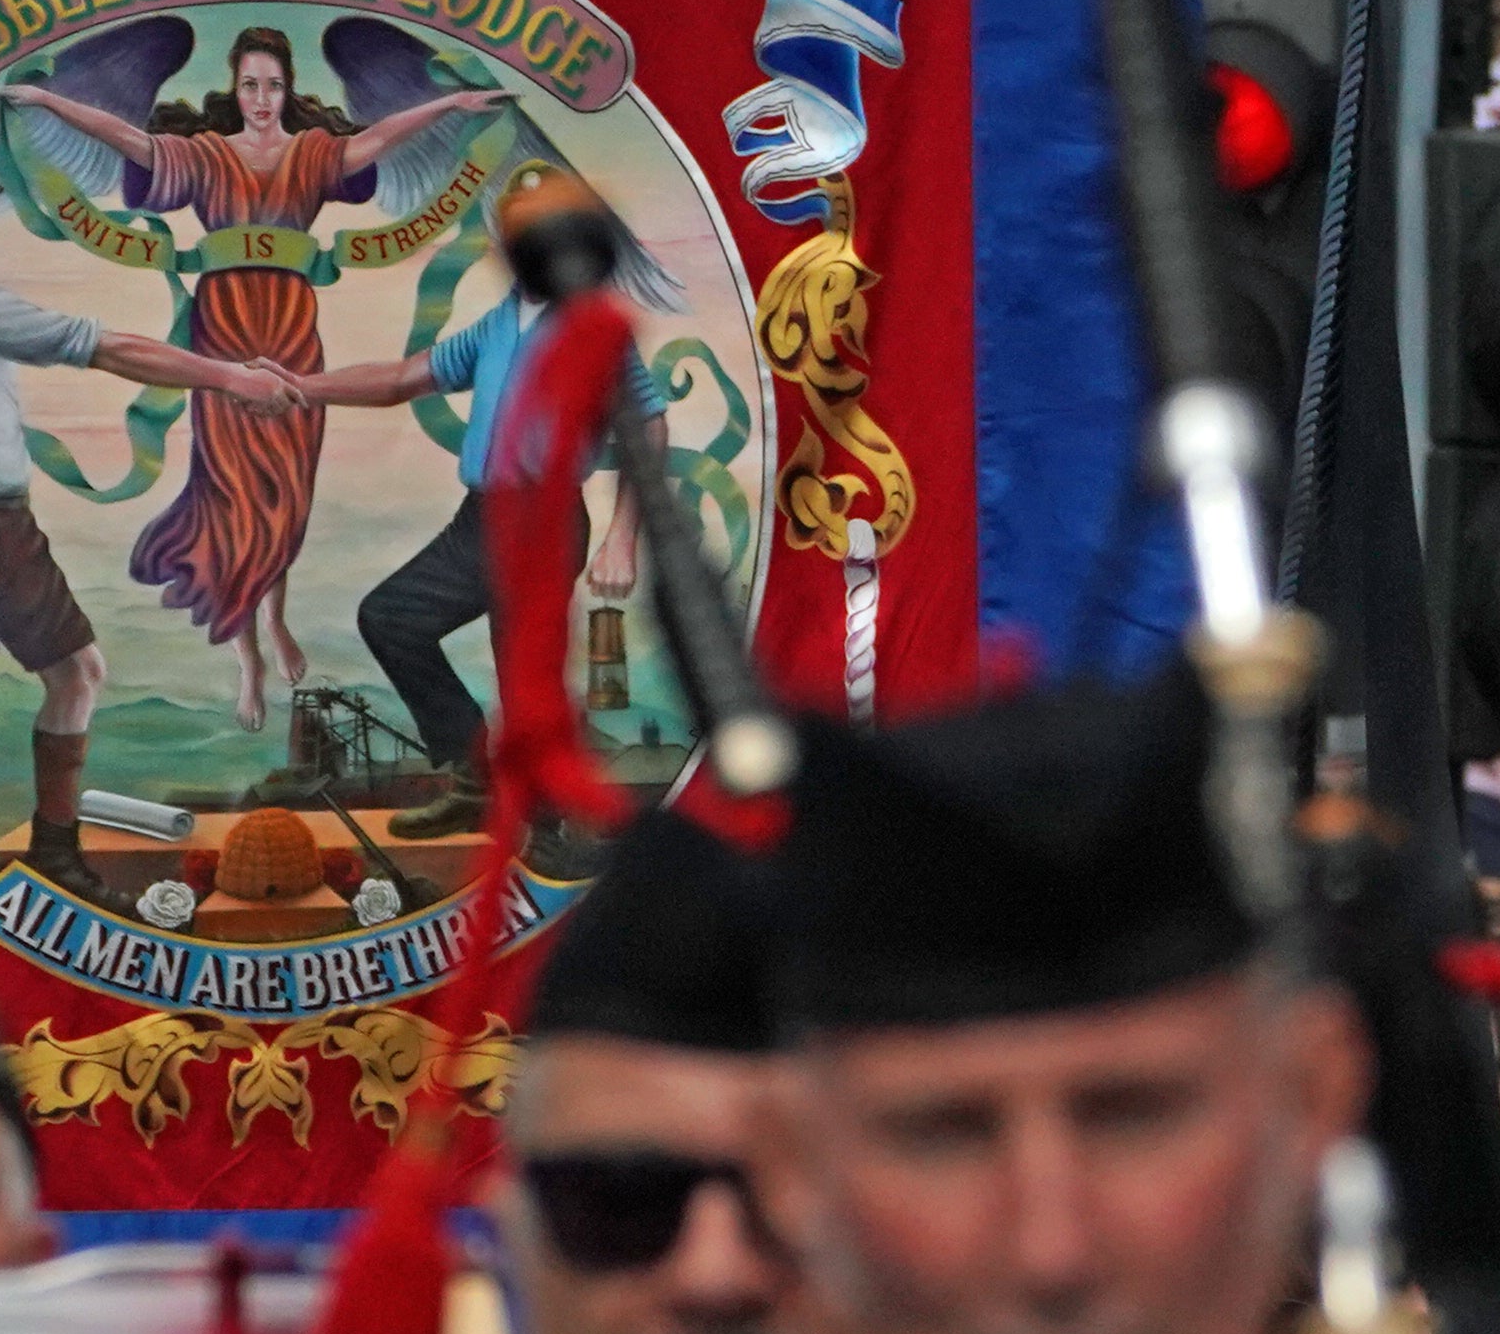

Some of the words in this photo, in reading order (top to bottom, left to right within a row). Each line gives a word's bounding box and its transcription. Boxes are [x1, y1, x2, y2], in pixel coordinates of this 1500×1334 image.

[57, 195, 161, 263] UNITY
[243, 233, 275, 259] IS
[350, 160, 487, 263] STRENGTH
[71, 919, 189, 1003] MEN
[190, 953, 293, 1013] ARE
